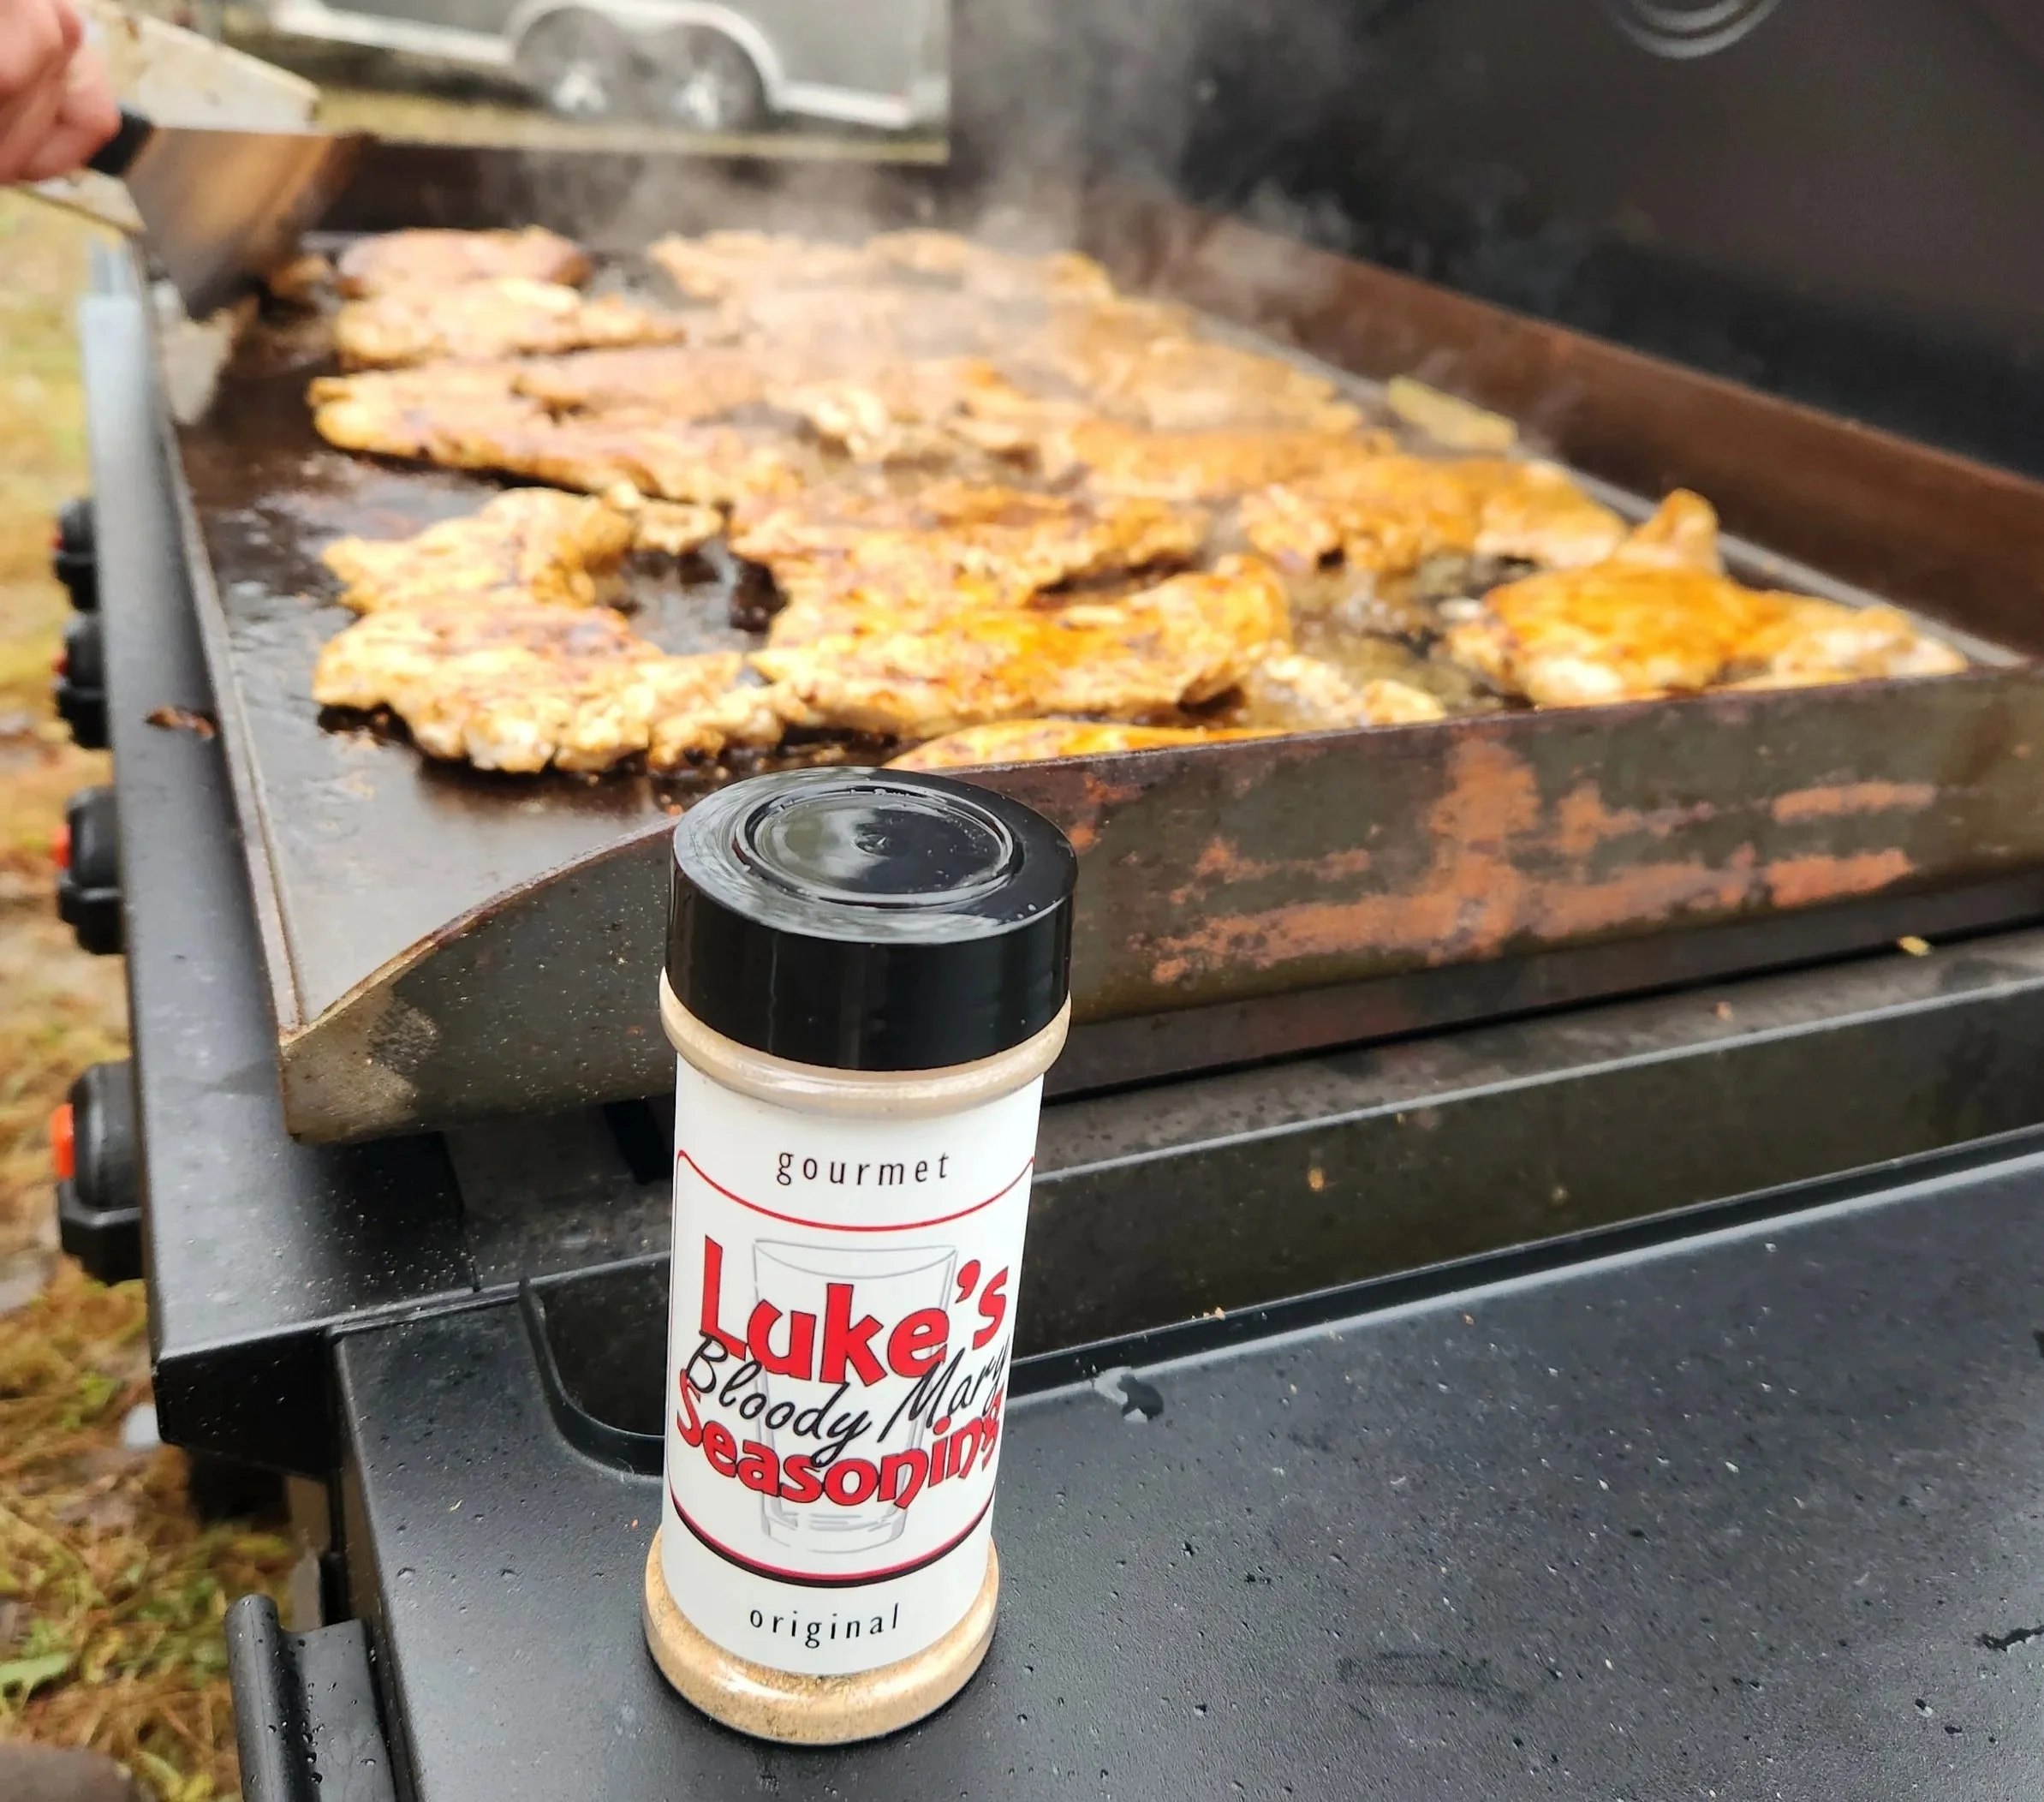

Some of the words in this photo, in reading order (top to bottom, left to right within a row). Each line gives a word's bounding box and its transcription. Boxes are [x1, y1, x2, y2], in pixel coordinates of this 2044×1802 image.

[777, 1152, 950, 1186] gourmet
[700, 1234, 1009, 1387] Luke's
[676, 1369, 1004, 1509] Seasoning
[686, 1330, 873, 1468] Bloody
[878, 1334, 1010, 1443] Mary
[749, 1602, 900, 1649] original
